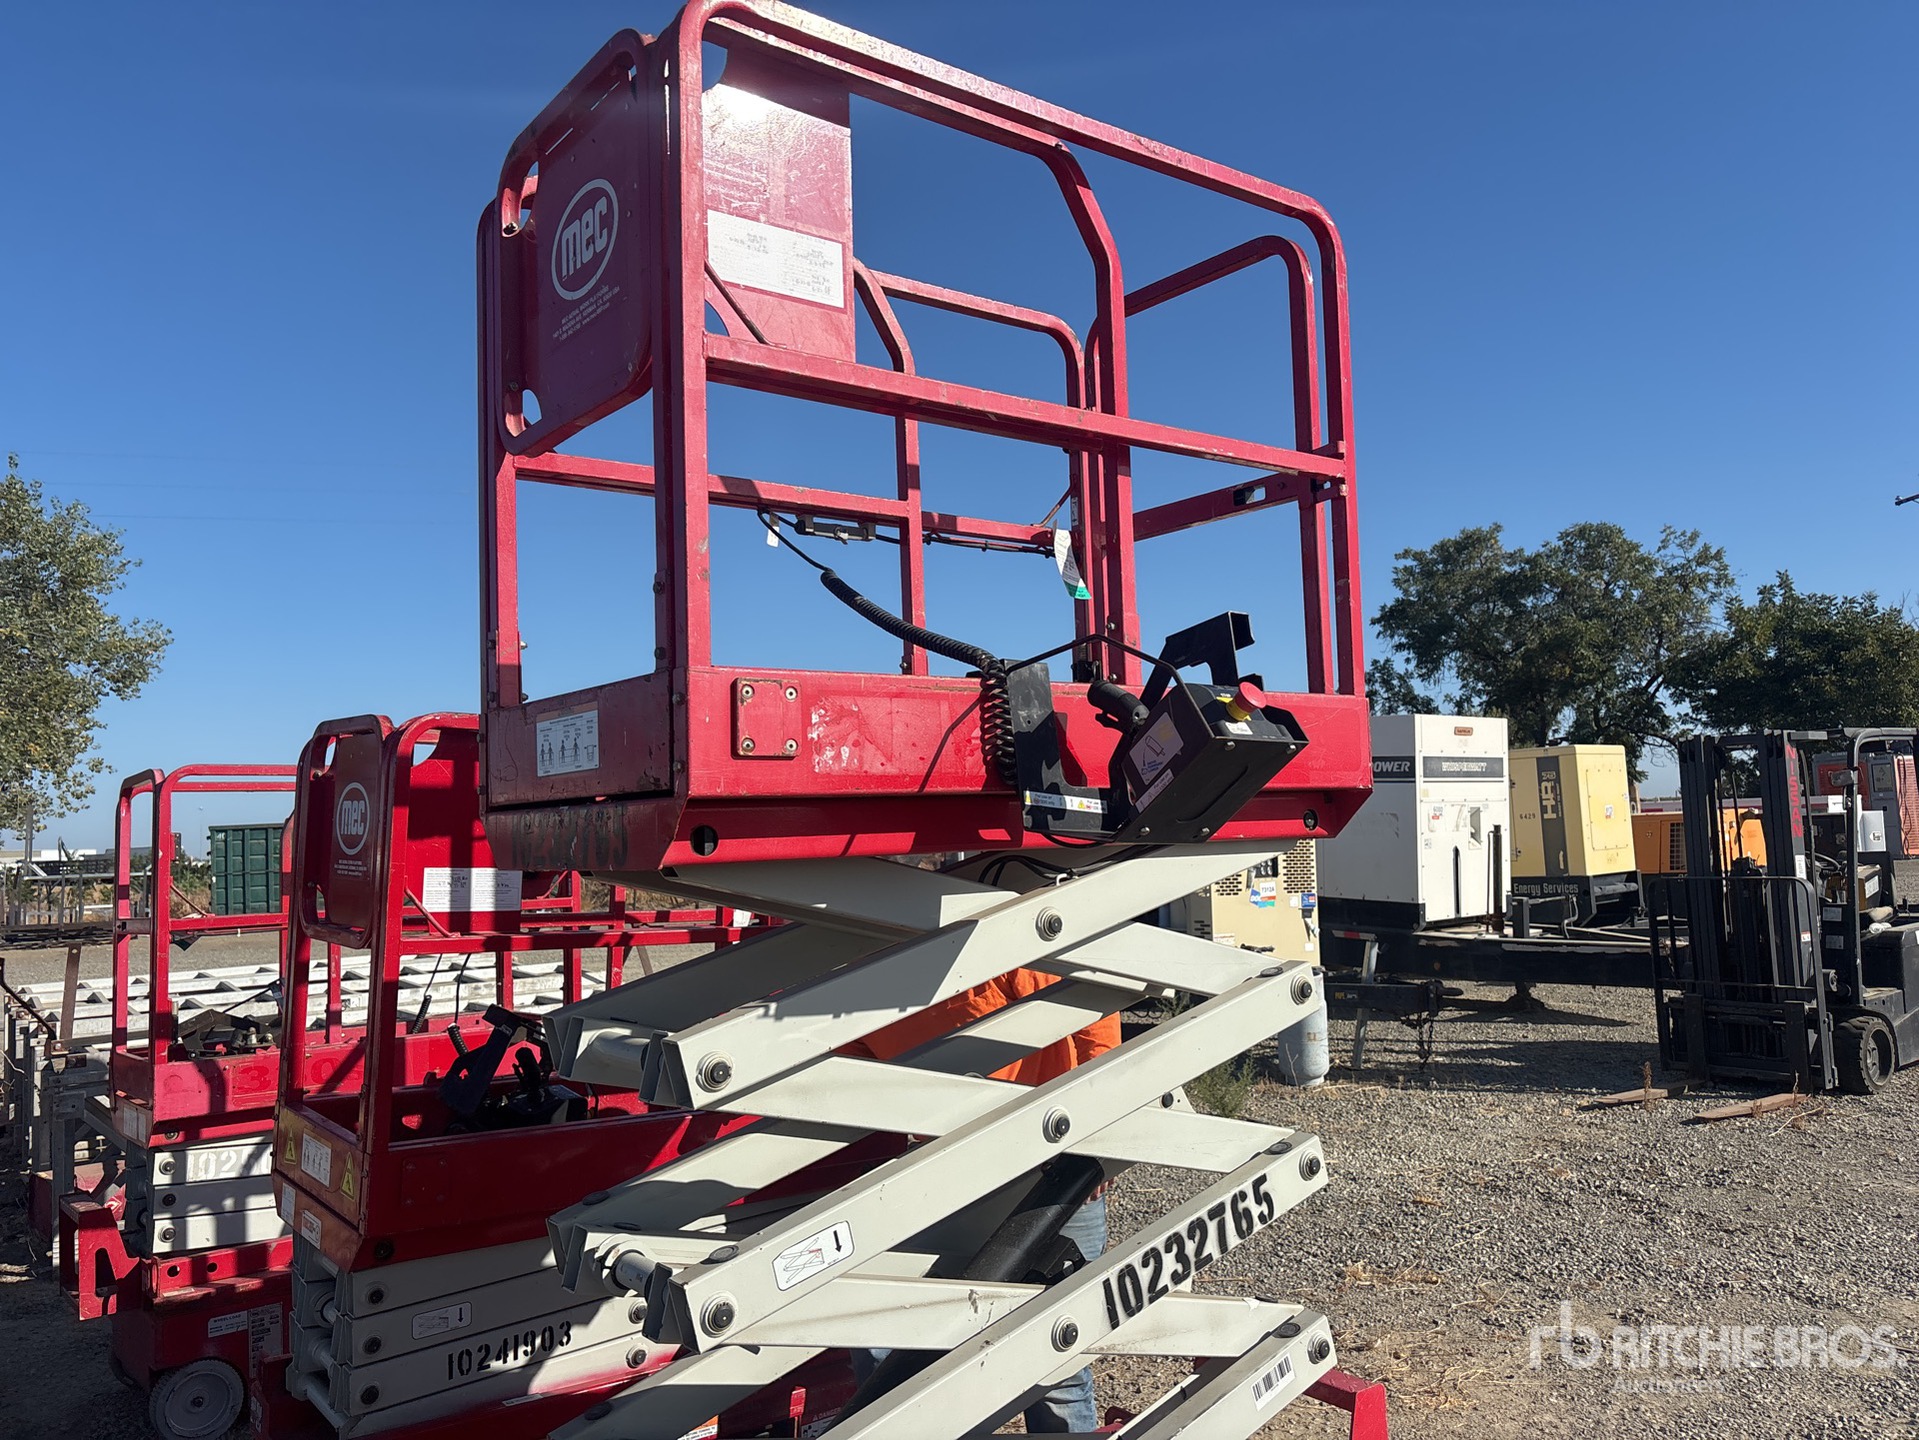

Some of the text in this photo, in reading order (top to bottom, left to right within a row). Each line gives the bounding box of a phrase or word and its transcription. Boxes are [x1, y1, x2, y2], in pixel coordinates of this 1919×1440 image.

[1373, 761, 1411, 773] OWER
[1786, 745, 1804, 838] NISSAN
[1513, 882, 1579, 896] Energy Services
[1103, 1173, 1275, 1330] 10232765
[447, 1320, 572, 1381] 10241903
